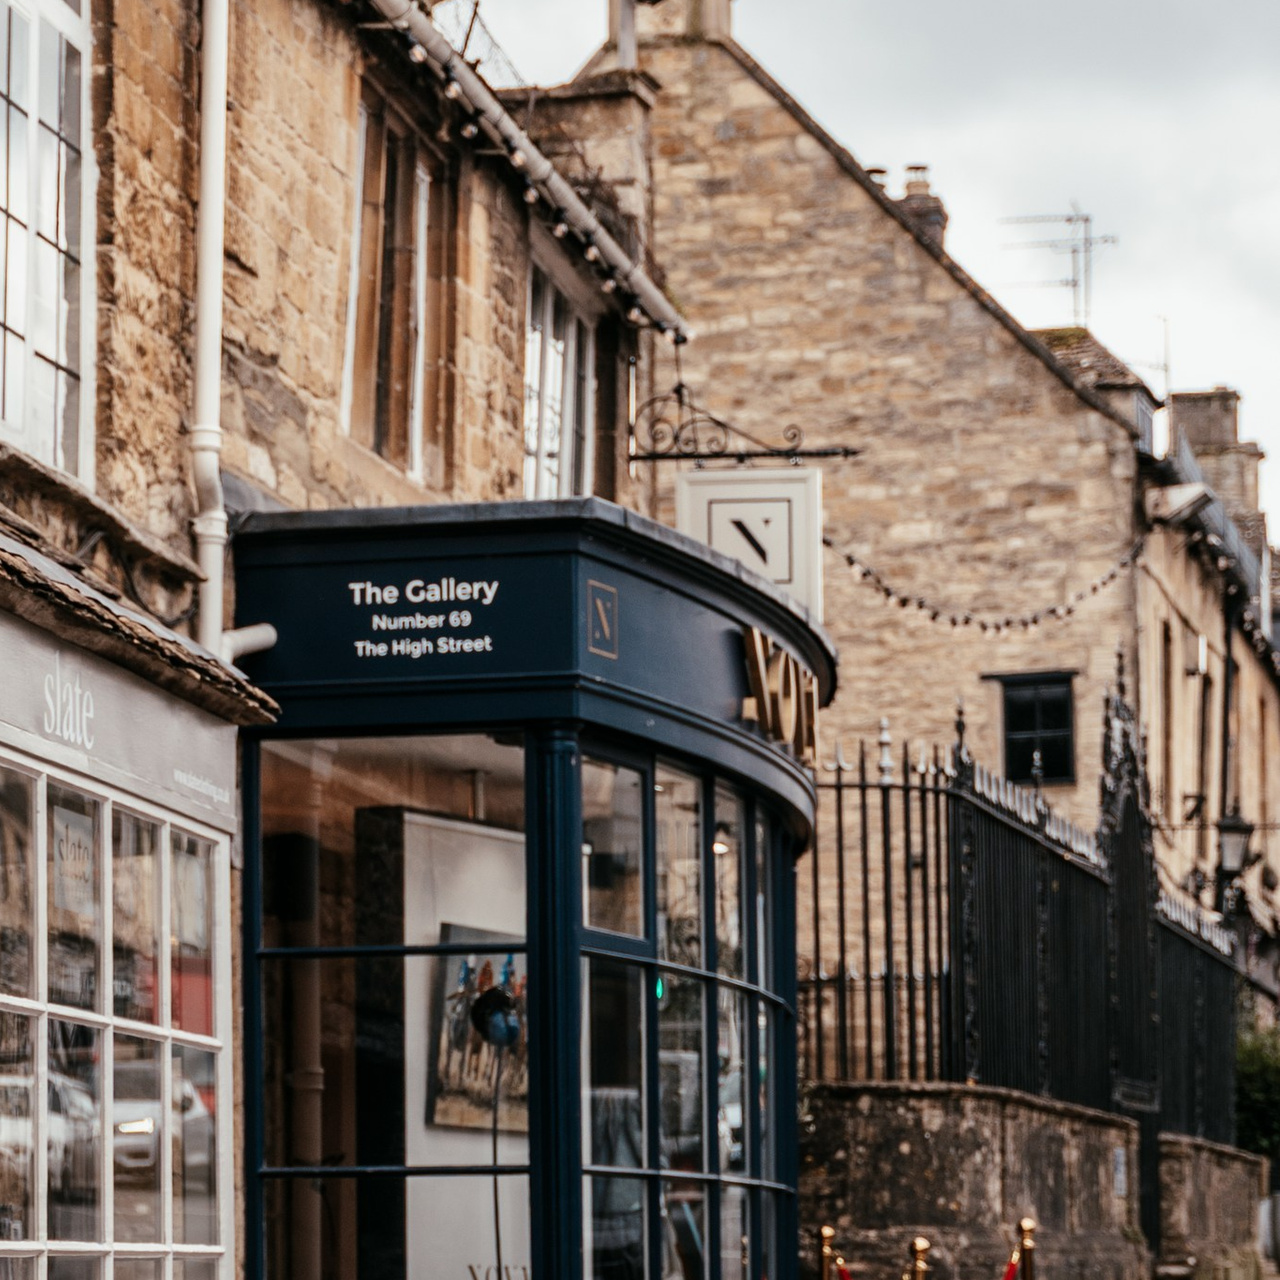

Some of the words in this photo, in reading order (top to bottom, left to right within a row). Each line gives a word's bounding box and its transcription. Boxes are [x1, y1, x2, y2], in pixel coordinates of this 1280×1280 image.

[348, 580, 400, 606] The
[404, 576, 500, 606] Gallery
[371, 611, 446, 631] Number
[448, 609, 472, 628] 69
[353, 639, 389, 658] The
[391, 636, 434, 659] High
[436, 635, 494, 655] Street
[42, 649, 95, 751] slate
